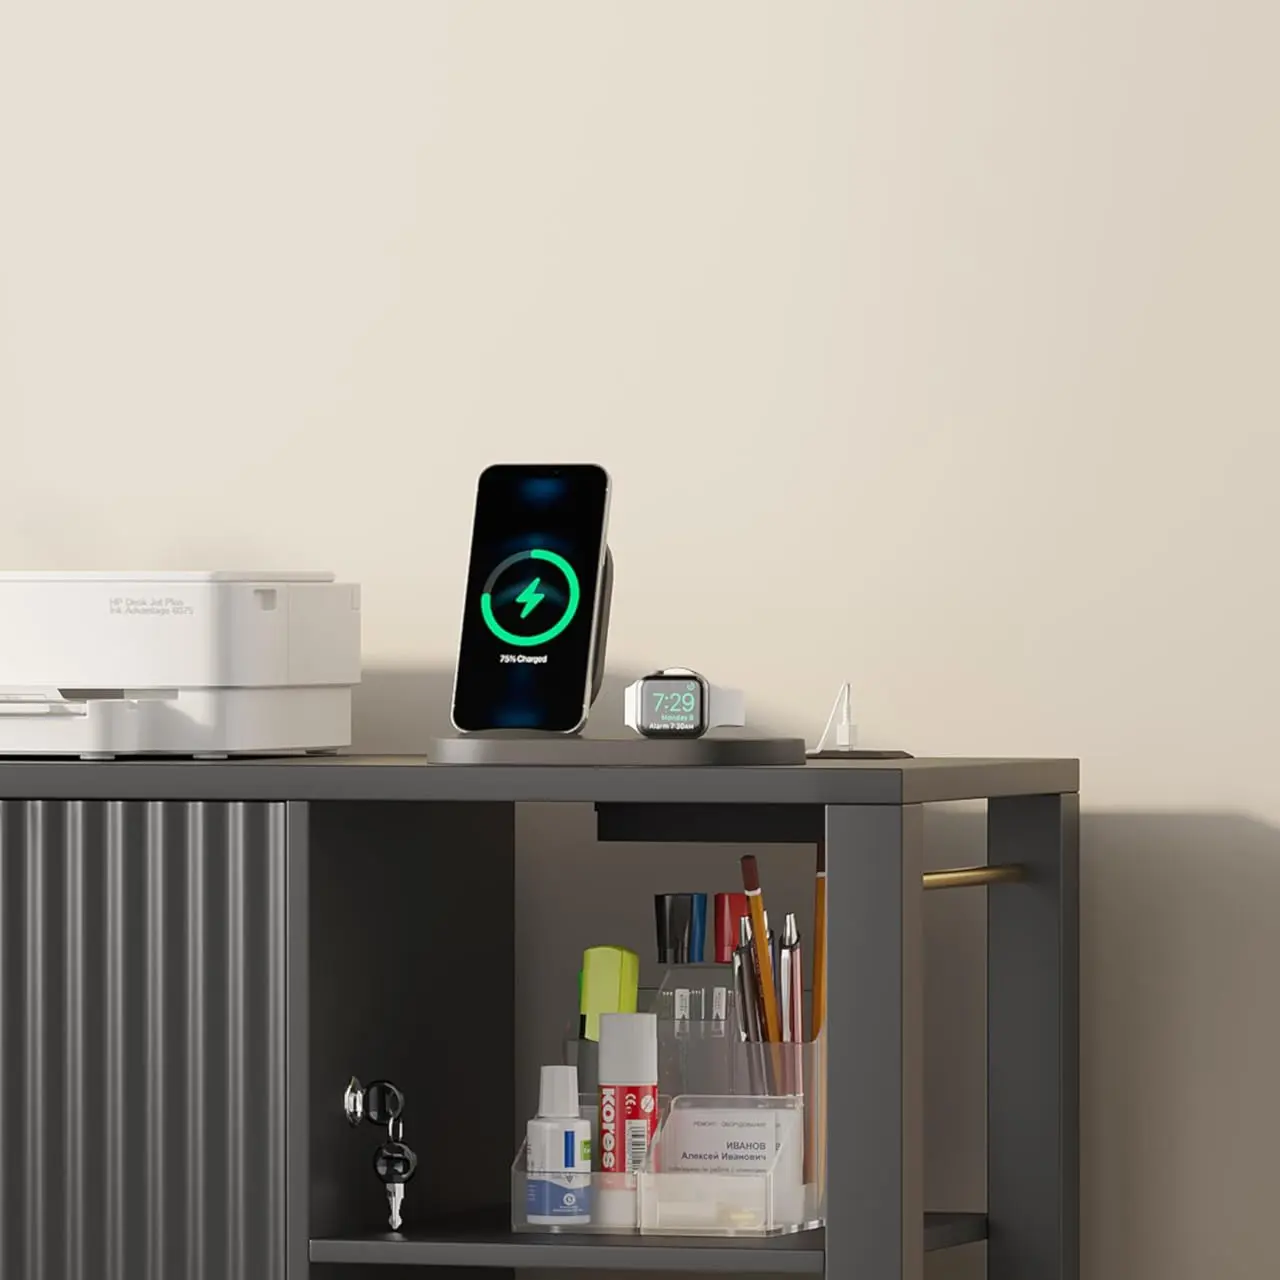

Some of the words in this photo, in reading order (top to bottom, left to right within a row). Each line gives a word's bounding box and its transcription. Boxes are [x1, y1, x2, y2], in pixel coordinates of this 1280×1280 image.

[652, 692, 695, 713] 7:29
[602, 1087, 615, 1169] Kores
[726, 1141, 768, 1151] ИВАНОВ
[681, 1151, 719, 1161] Алексей
[721, 1152, 767, 1161] Иванович
